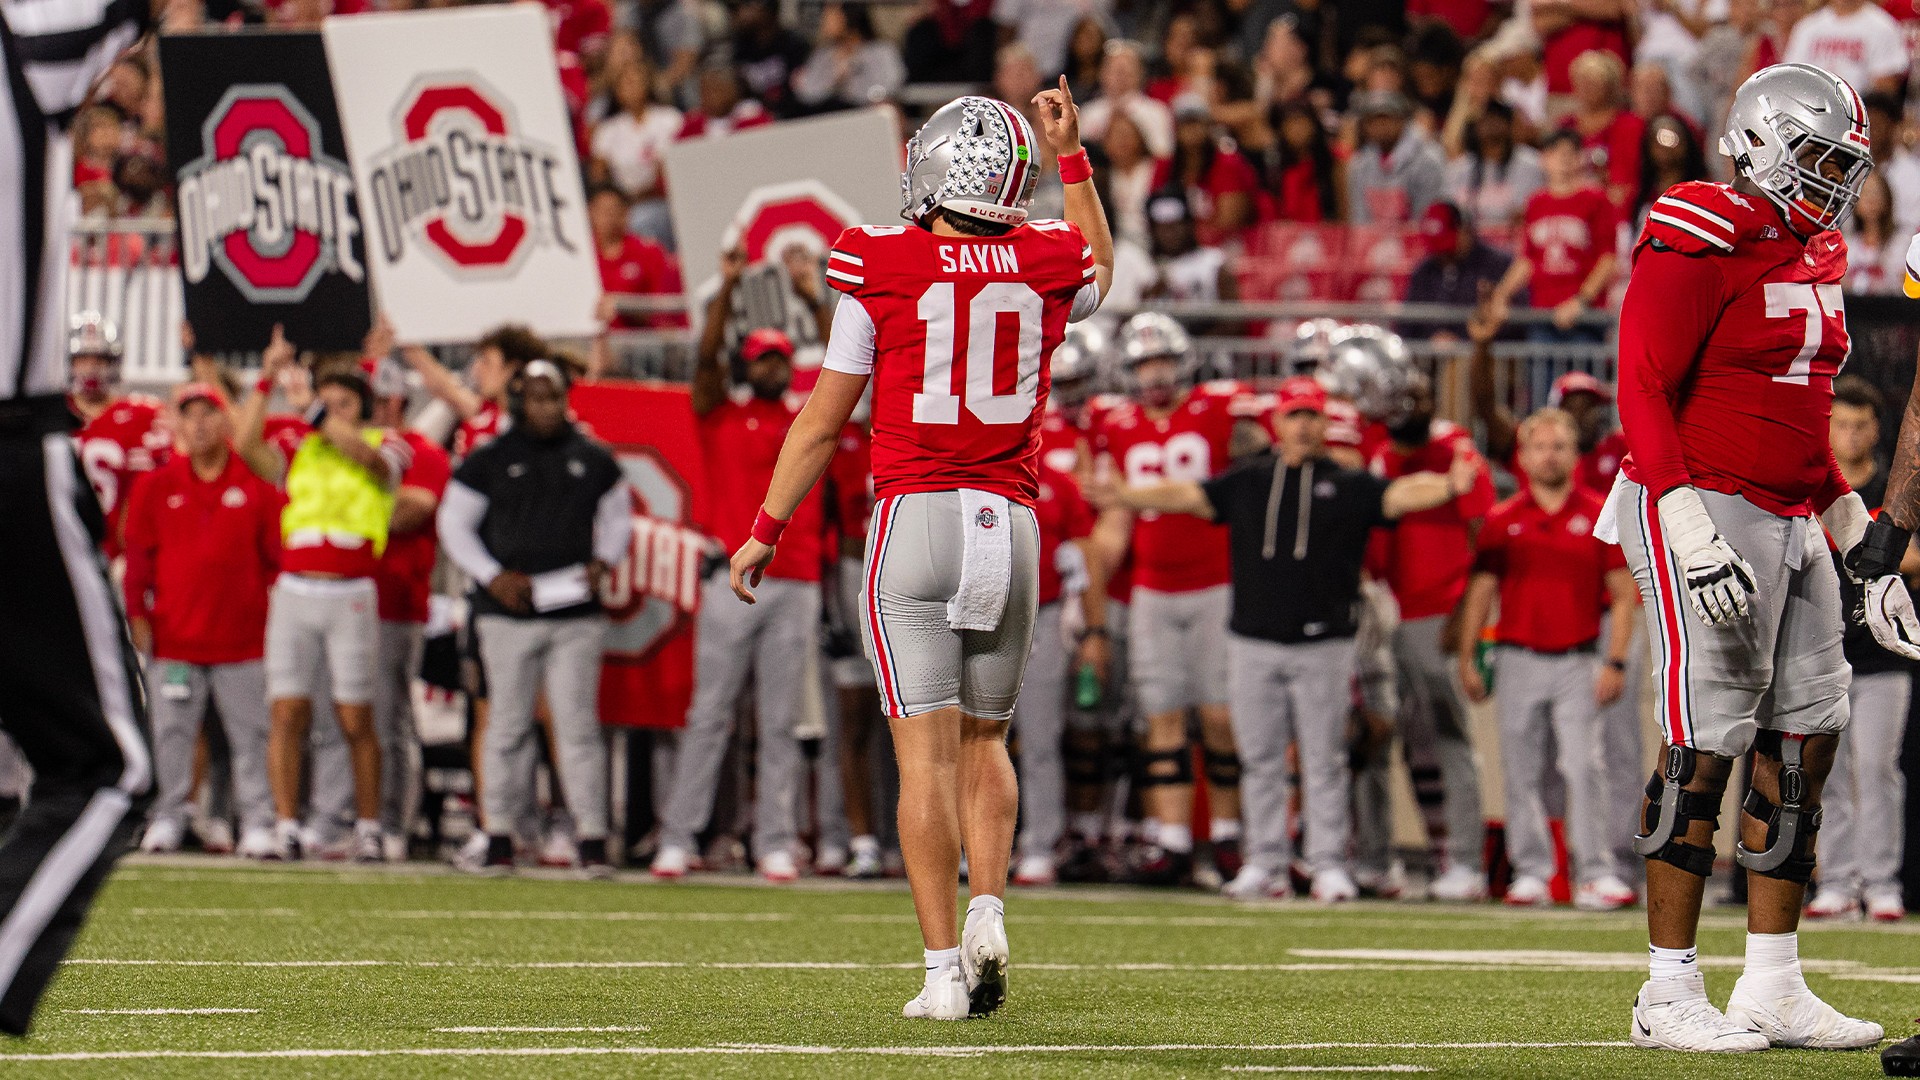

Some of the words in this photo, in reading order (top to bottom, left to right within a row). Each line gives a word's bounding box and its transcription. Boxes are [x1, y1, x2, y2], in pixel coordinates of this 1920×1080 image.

[987, 184, 998, 195] 10
[938, 244, 1019, 273] SAYIN
[912, 282, 1044, 425] 10
